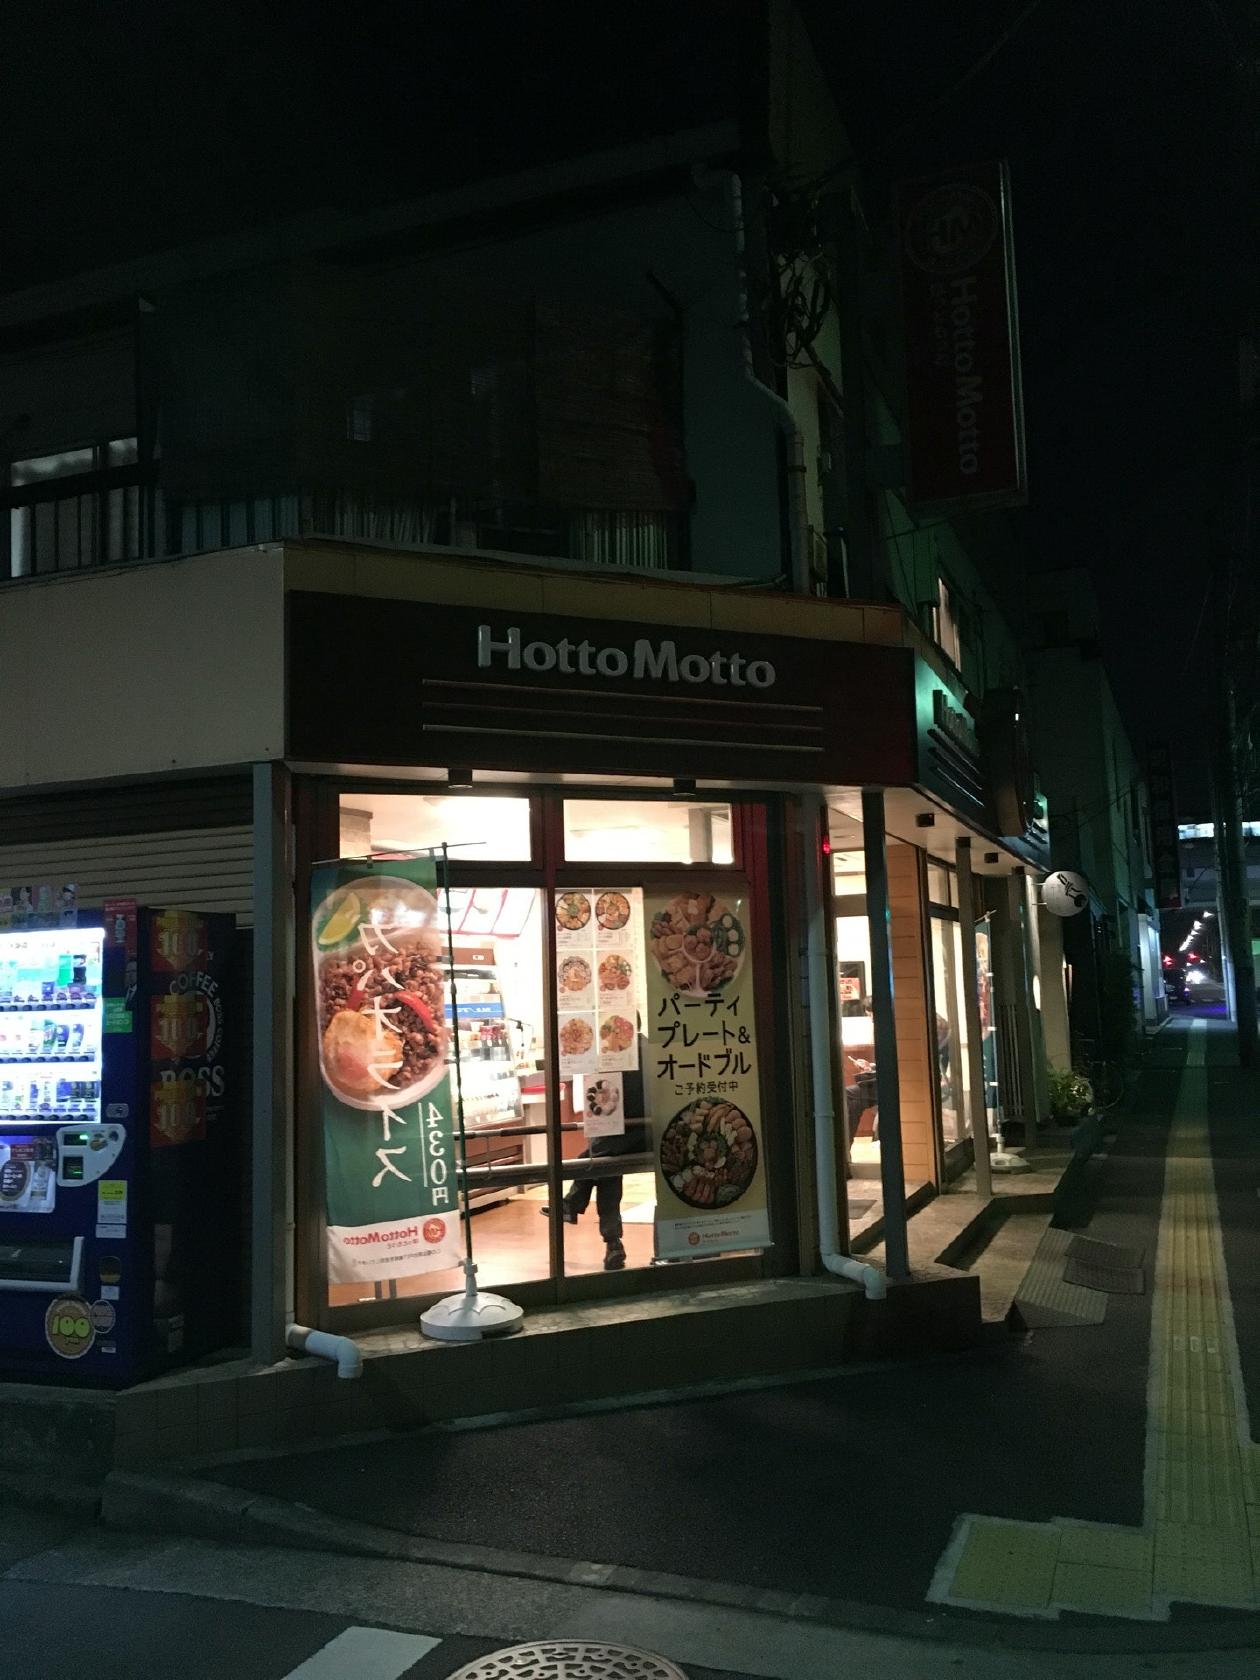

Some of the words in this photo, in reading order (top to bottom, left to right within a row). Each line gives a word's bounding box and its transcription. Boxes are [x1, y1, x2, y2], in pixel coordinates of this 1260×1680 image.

[951, 276, 983, 474] HottoMotto
[477, 624, 776, 688] HottoMotto
[169, 971, 219, 997] COFFEE
[658, 992, 741, 1017] パーティ
[657, 1020, 752, 1048] プレート&
[657, 1048, 752, 1080] オードブル
[675, 1081, 739, 1096] ご予約受付中
[52, 1315, 92, 1338] 100
